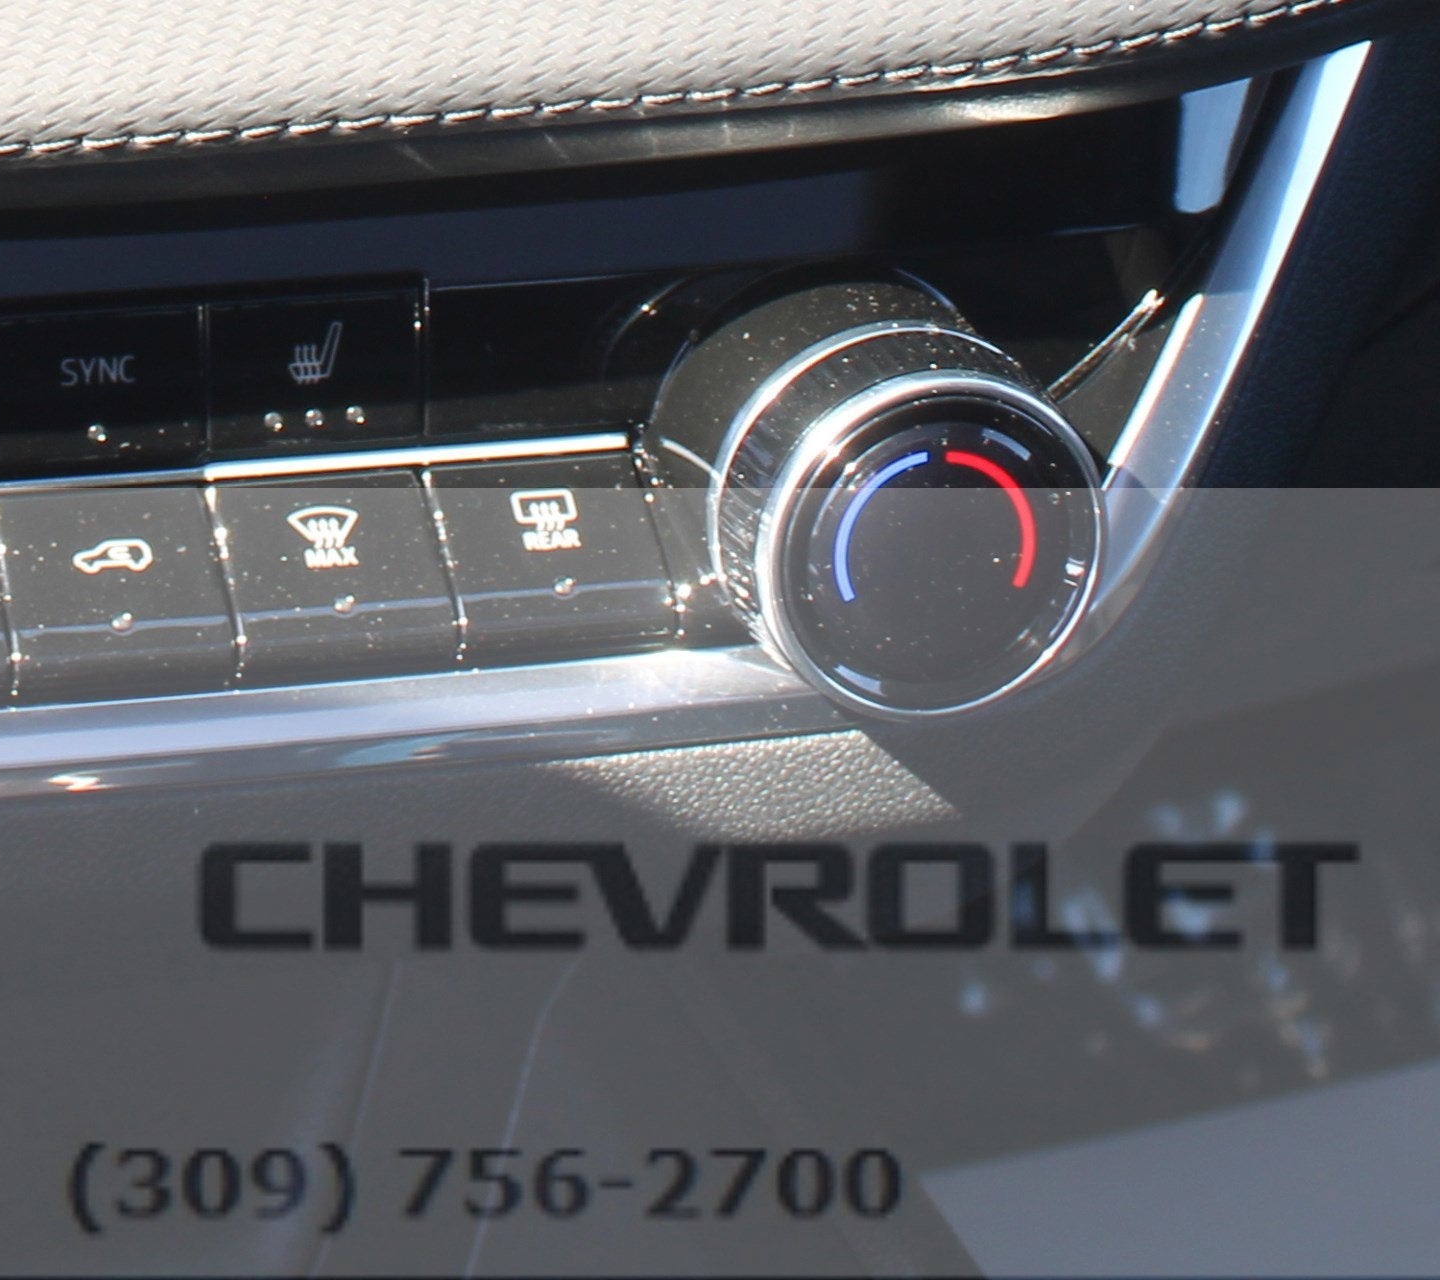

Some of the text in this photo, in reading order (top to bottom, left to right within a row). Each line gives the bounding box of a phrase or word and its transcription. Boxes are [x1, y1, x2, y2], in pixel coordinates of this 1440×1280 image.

[60, 353, 136, 388] SYNC
[523, 528, 581, 551] REAR
[304, 546, 359, 568] MAX
